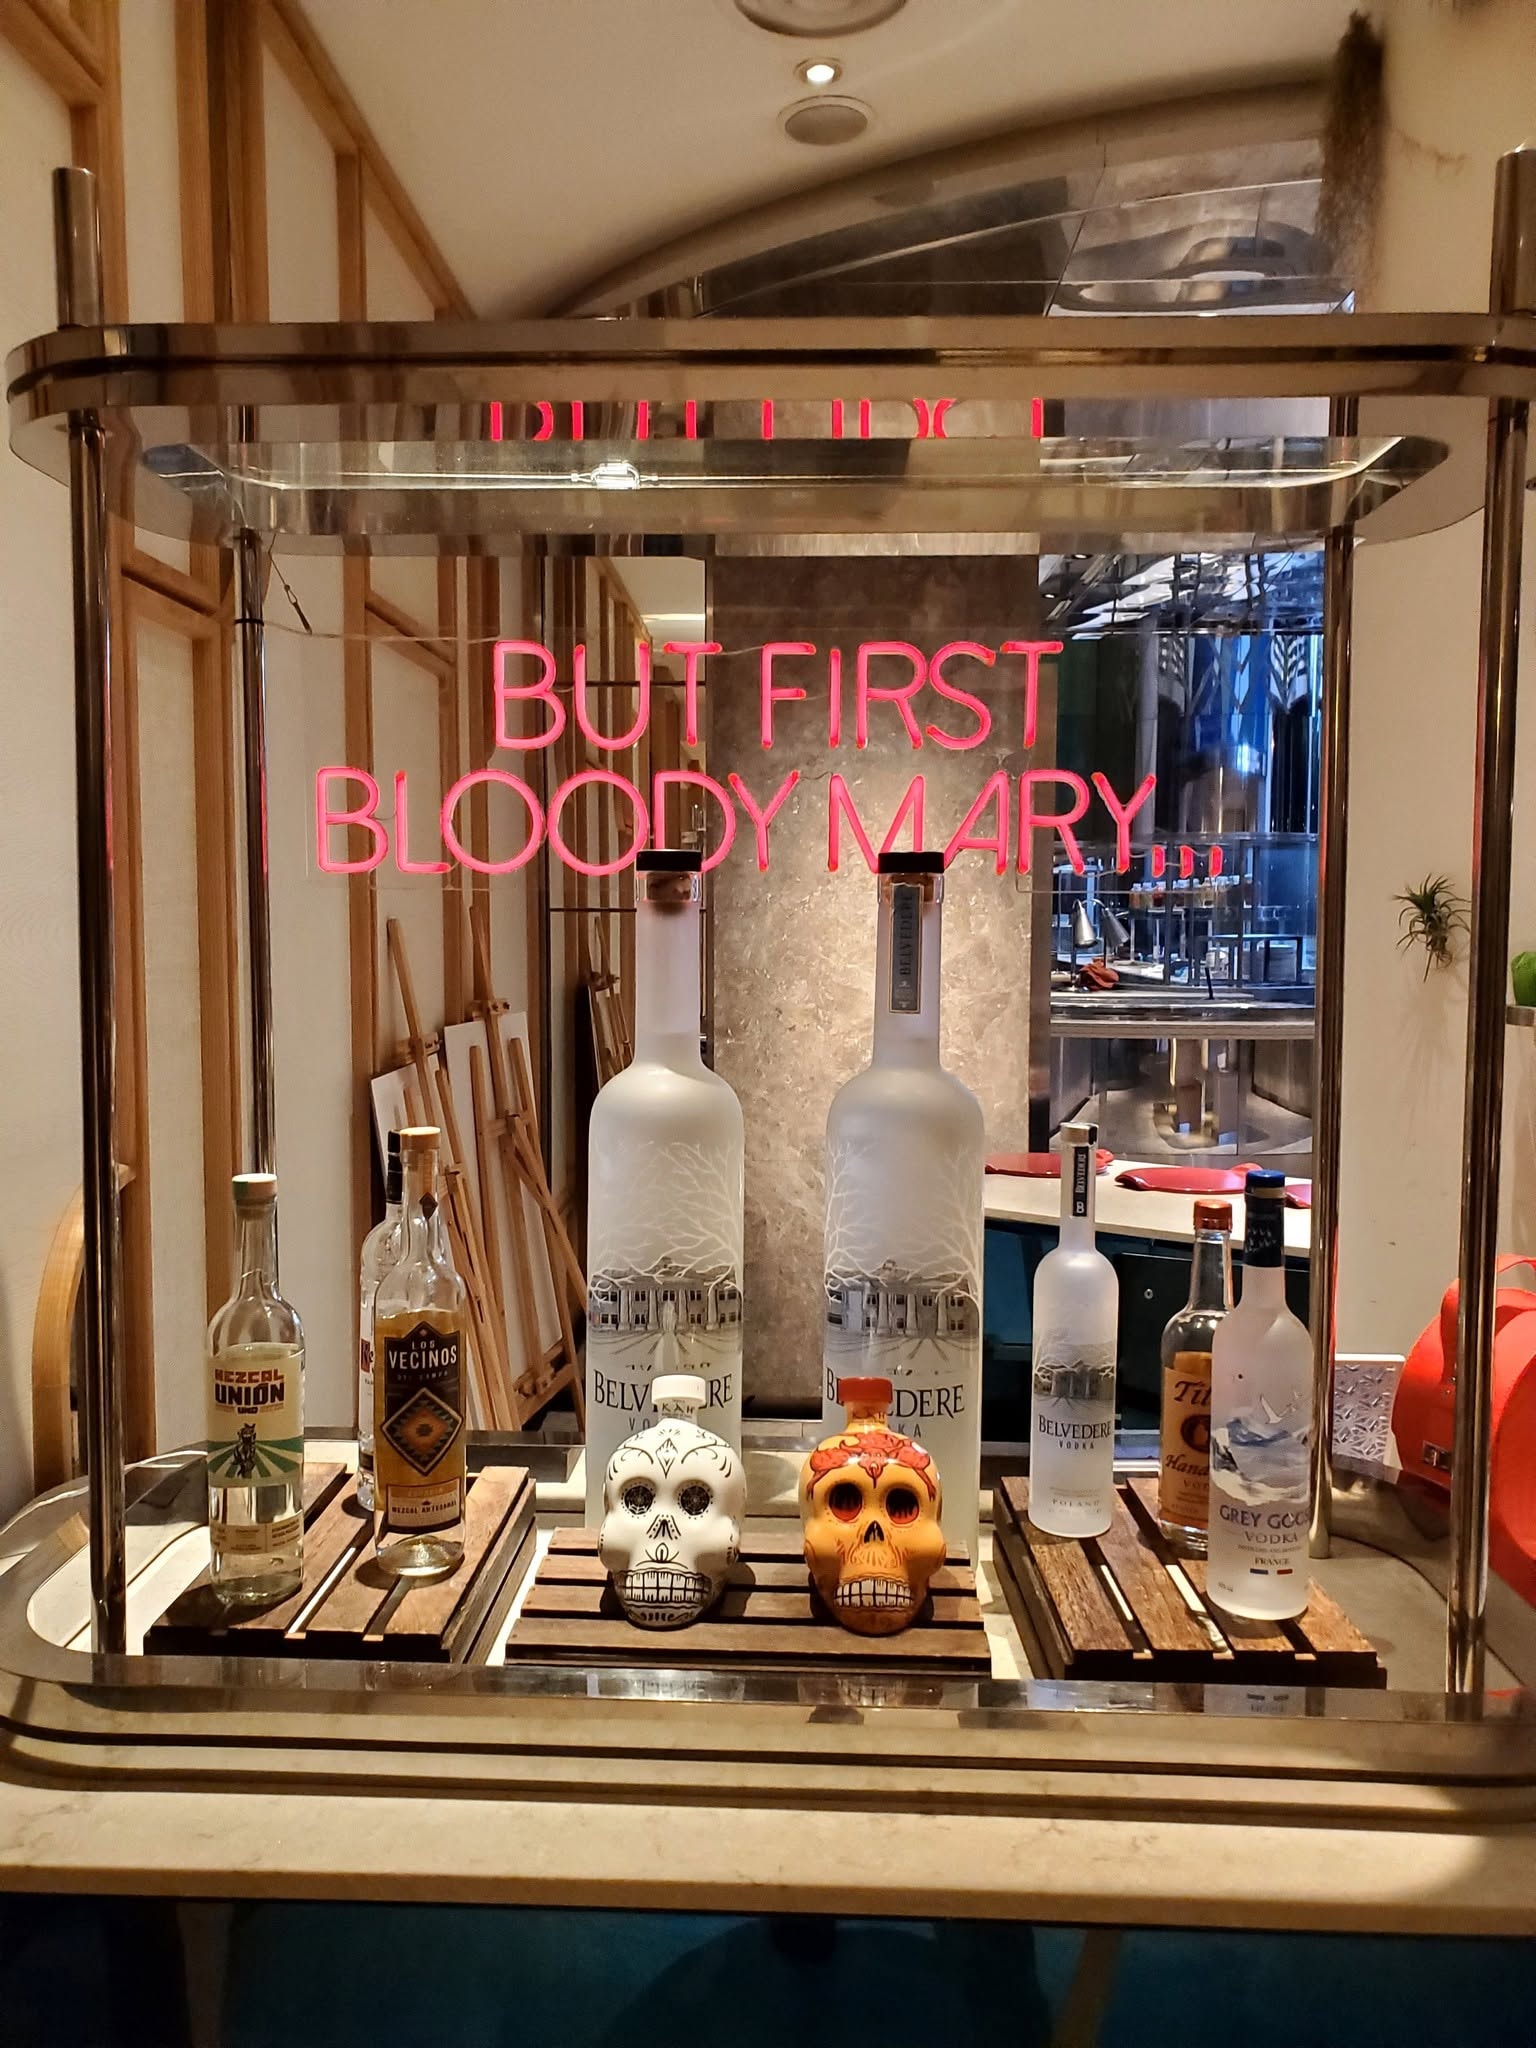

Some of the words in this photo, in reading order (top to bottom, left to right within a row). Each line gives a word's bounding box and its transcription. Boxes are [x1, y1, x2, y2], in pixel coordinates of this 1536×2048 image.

[493, 639, 723, 751] BUT
[760, 639, 1065, 751] FIRST
[315, 765, 801, 878] BLOODY
[827, 770, 1223, 878] MARY...
[388, 1344, 458, 1370] VECINOS
[411, 1340, 436, 1351] LOS
[214, 1368, 285, 1384] MEZCAL
[214, 1382, 285, 1406] UNIÓN
[593, 1368, 734, 1414] BELVRE
[826, 1366, 966, 1420] BDERE
[1038, 1412, 1112, 1440] BELVEDERE
[1058, 1440, 1095, 1450] VODKA
[1219, 1504, 1262, 1528] GREY
[1243, 1530, 1299, 1545] VODKA
